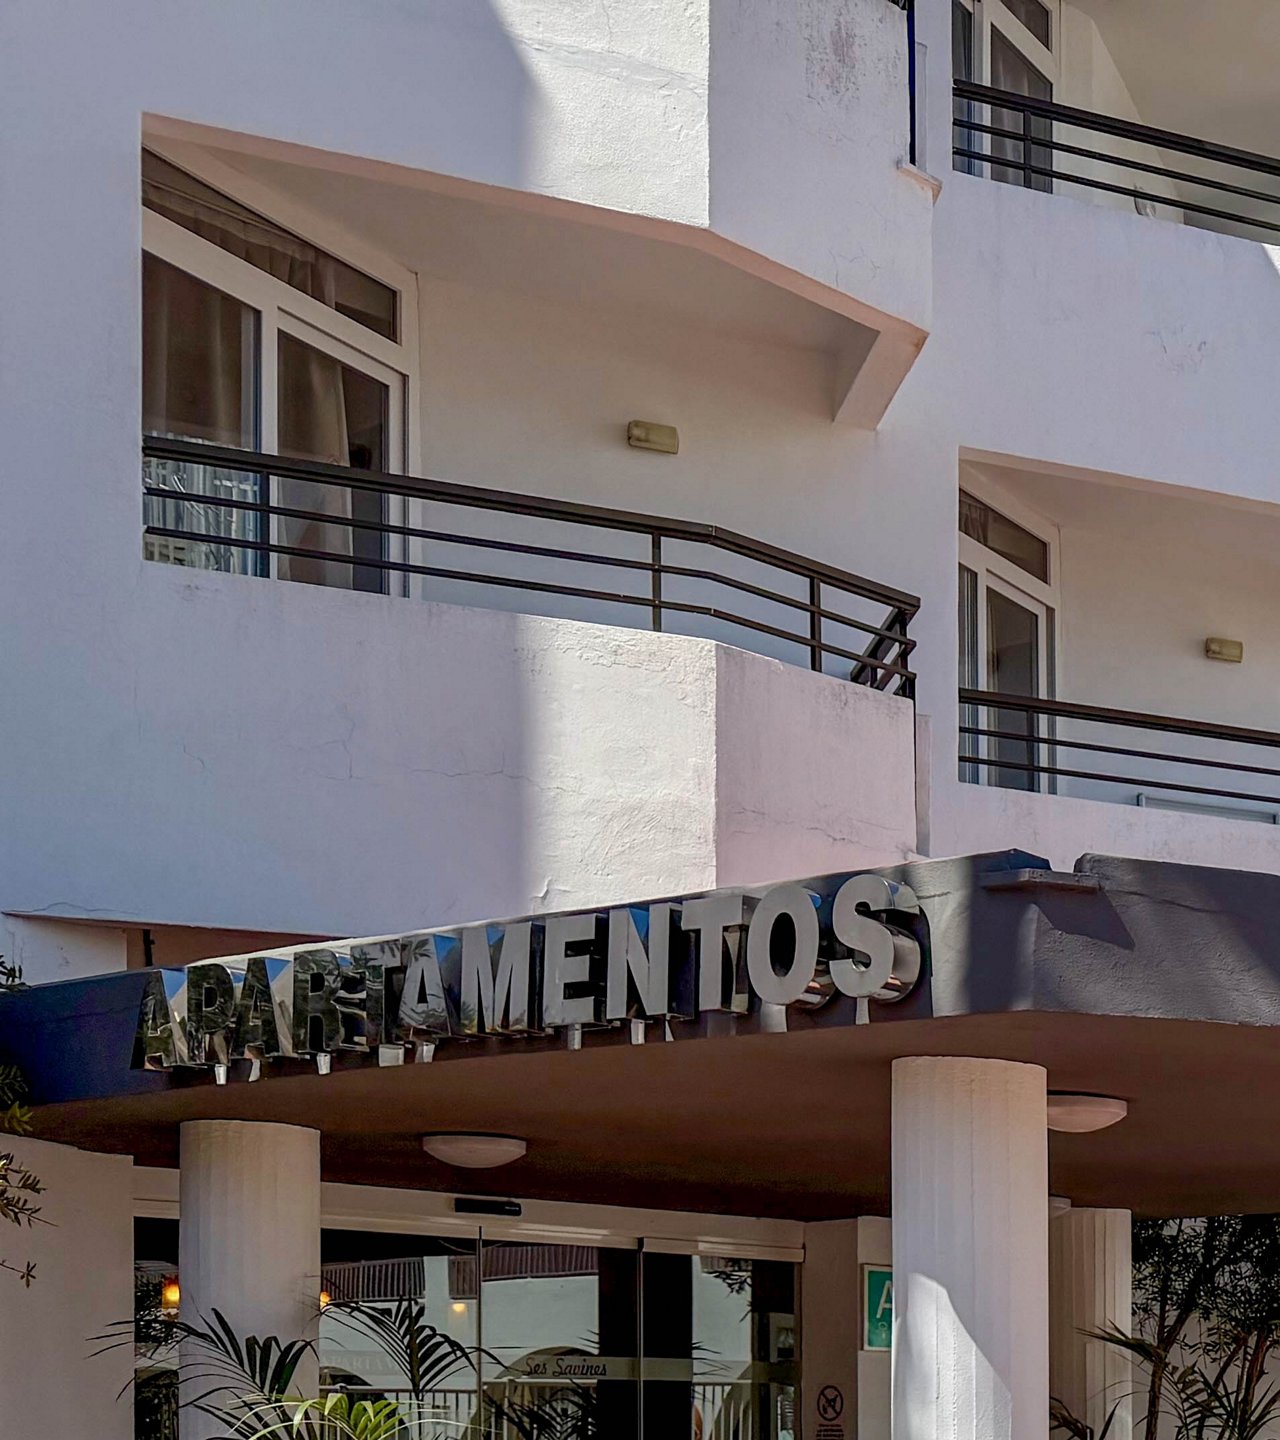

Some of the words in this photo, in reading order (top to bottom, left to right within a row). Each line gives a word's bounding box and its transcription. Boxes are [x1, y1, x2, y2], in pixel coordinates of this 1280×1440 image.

[135, 873, 918, 1070] APARTAMENTOS
[523, 1356, 547, 1376] Ses
[553, 1357, 607, 1377] Savines
